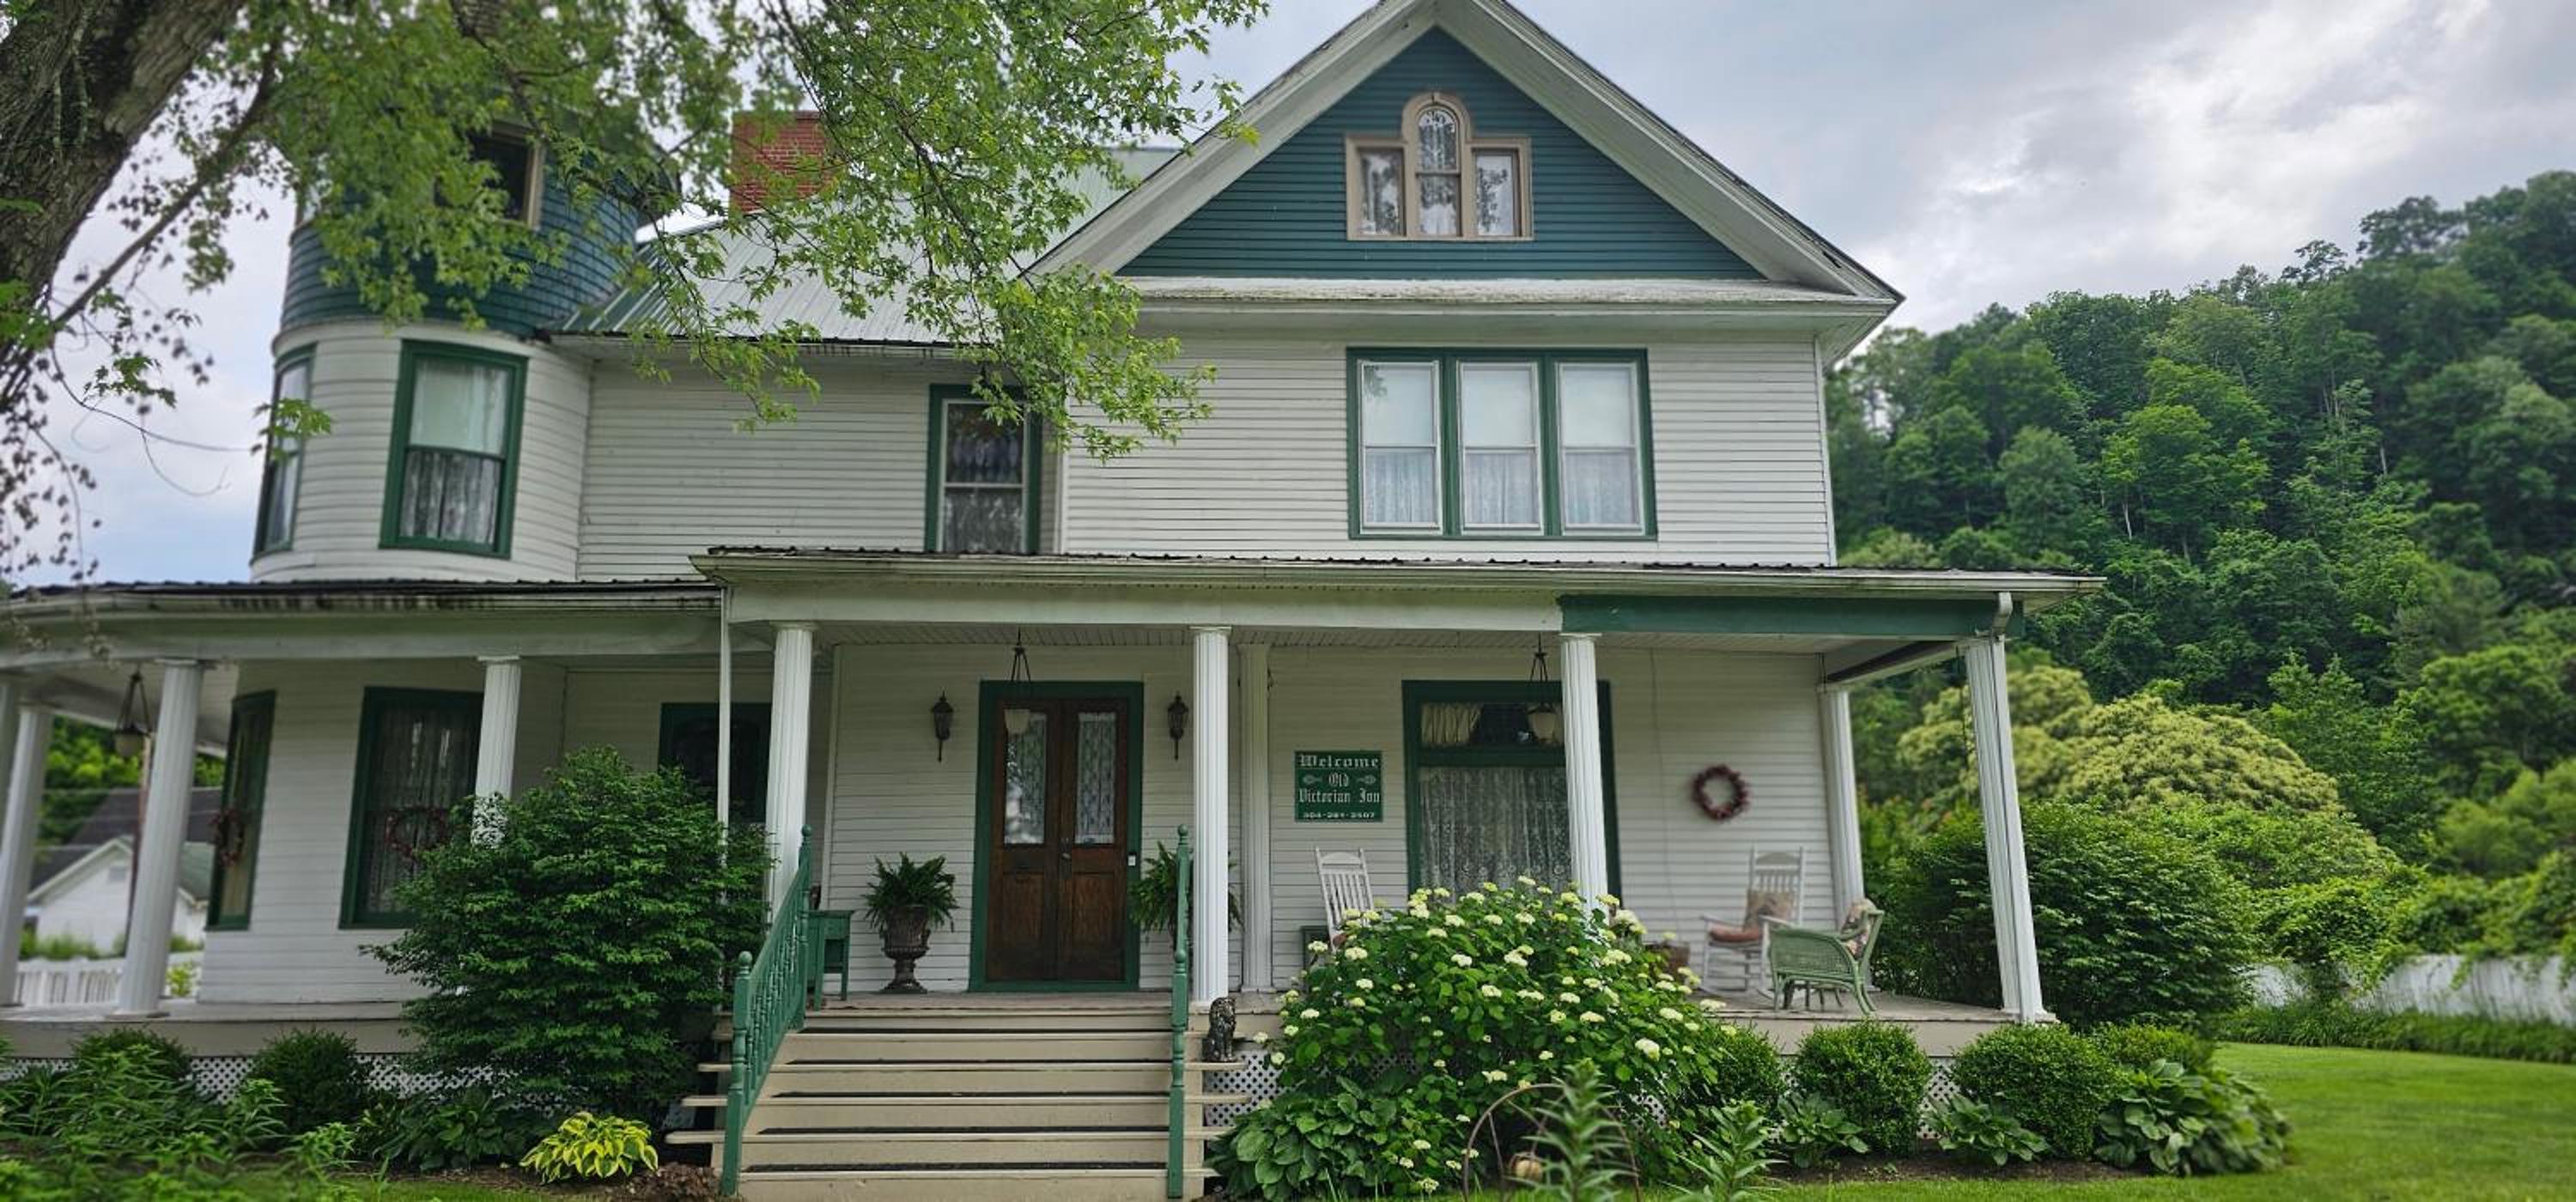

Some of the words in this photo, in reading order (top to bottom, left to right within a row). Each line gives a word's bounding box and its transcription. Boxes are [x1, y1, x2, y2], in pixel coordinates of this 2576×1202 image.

[1299, 754, 1378, 768] Welcome
[1328, 772, 1349, 787] Old
[1299, 787, 1351, 804] Victorian
[1359, 787, 1380, 803] Inn
